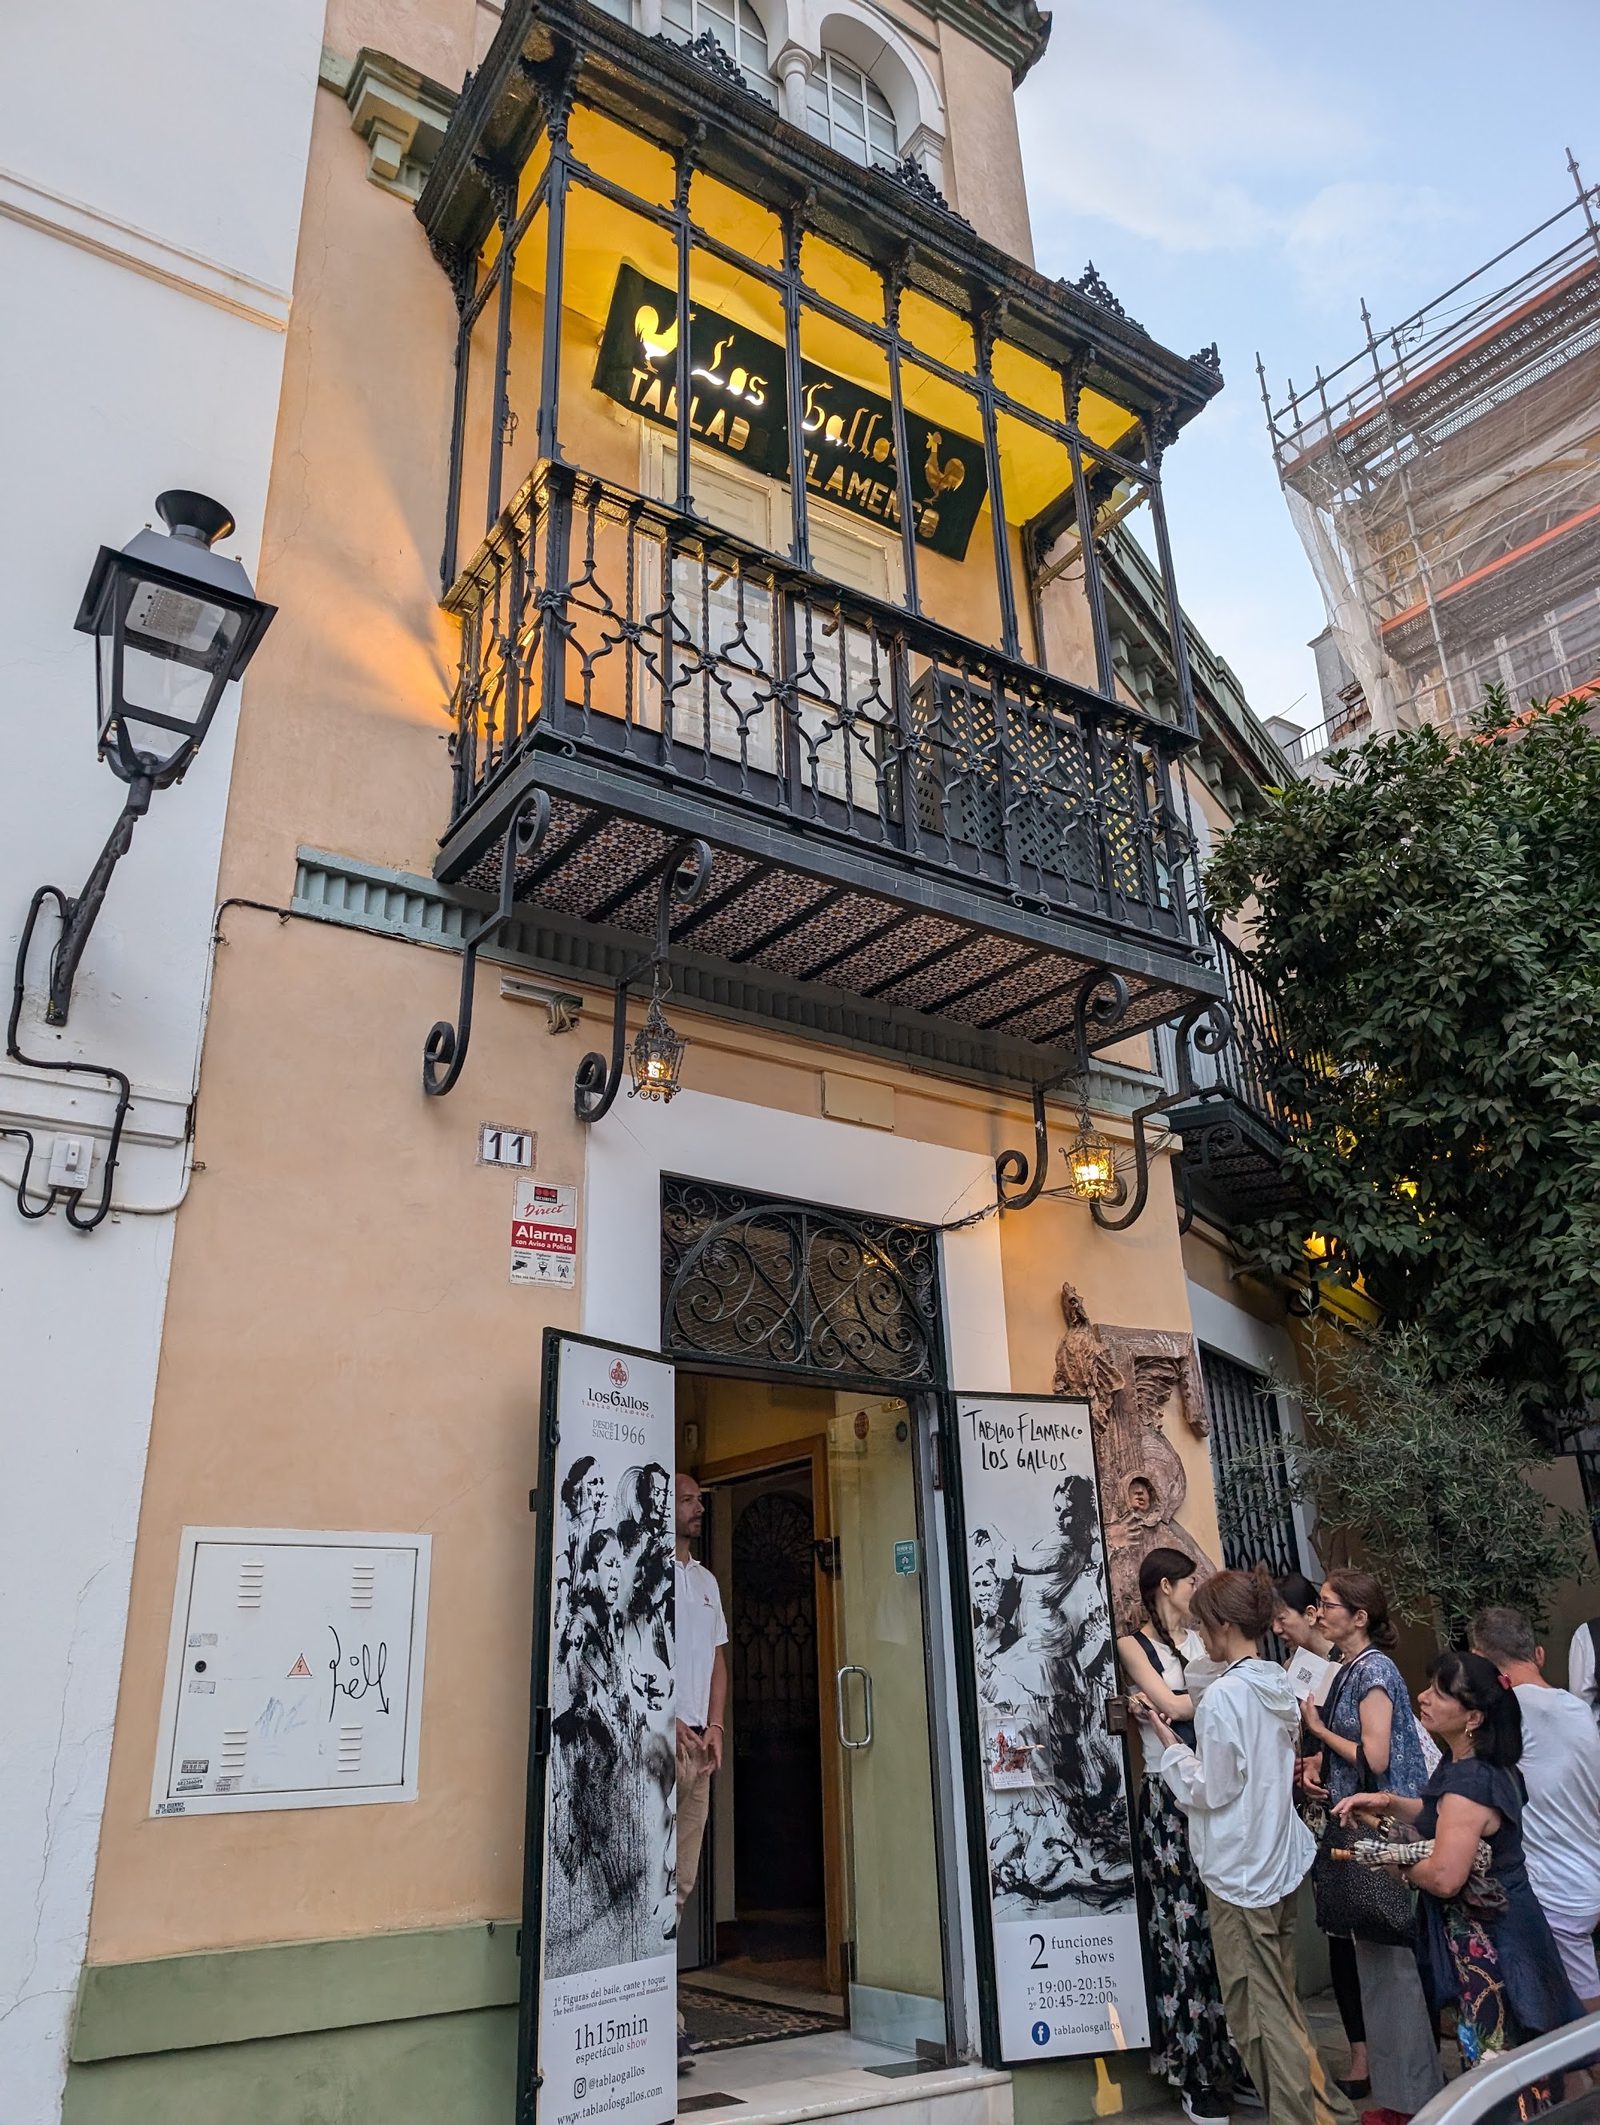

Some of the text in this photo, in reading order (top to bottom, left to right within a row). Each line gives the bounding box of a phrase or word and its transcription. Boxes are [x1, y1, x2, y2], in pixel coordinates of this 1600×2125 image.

[690, 334, 769, 407] Los
[489, 1132, 525, 1164] 11
[523, 1203, 568, 1217] Direct
[516, 1225, 573, 1243] Alarma
[528, 1240, 546, 1248] Aviso
[592, 1419, 614, 1431] DESDE
[592, 1423, 646, 1446] SINCE 1966
[981, 1442, 1067, 1474] LOS GALLOS
[1029, 1933, 1113, 1970] 2 funciones
[1075, 1950, 1115, 1965] shows
[553, 2009, 562, 2017] The
[563, 2005, 574, 2014] best
[575, 2000, 597, 2011] flamenco
[636, 1988, 646, 1996] and
[563, 1992, 589, 2006] Figuras
[591, 1988, 601, 1999] del
[604, 1984, 622, 1996] baile,
[623, 1980, 641, 1991] cante
[642, 1979, 647, 1987] y
[647, 1975, 666, 1987] toque
[574, 2014, 648, 2051] 1h15min
[1054, 2021, 1120, 2036] tablaolosgallos
[575, 2036, 648, 2066] espectáculo show
[588, 2065, 646, 2090] @tablaogallos
[557, 2084, 663, 2125] www.tablaolosgallos.com
